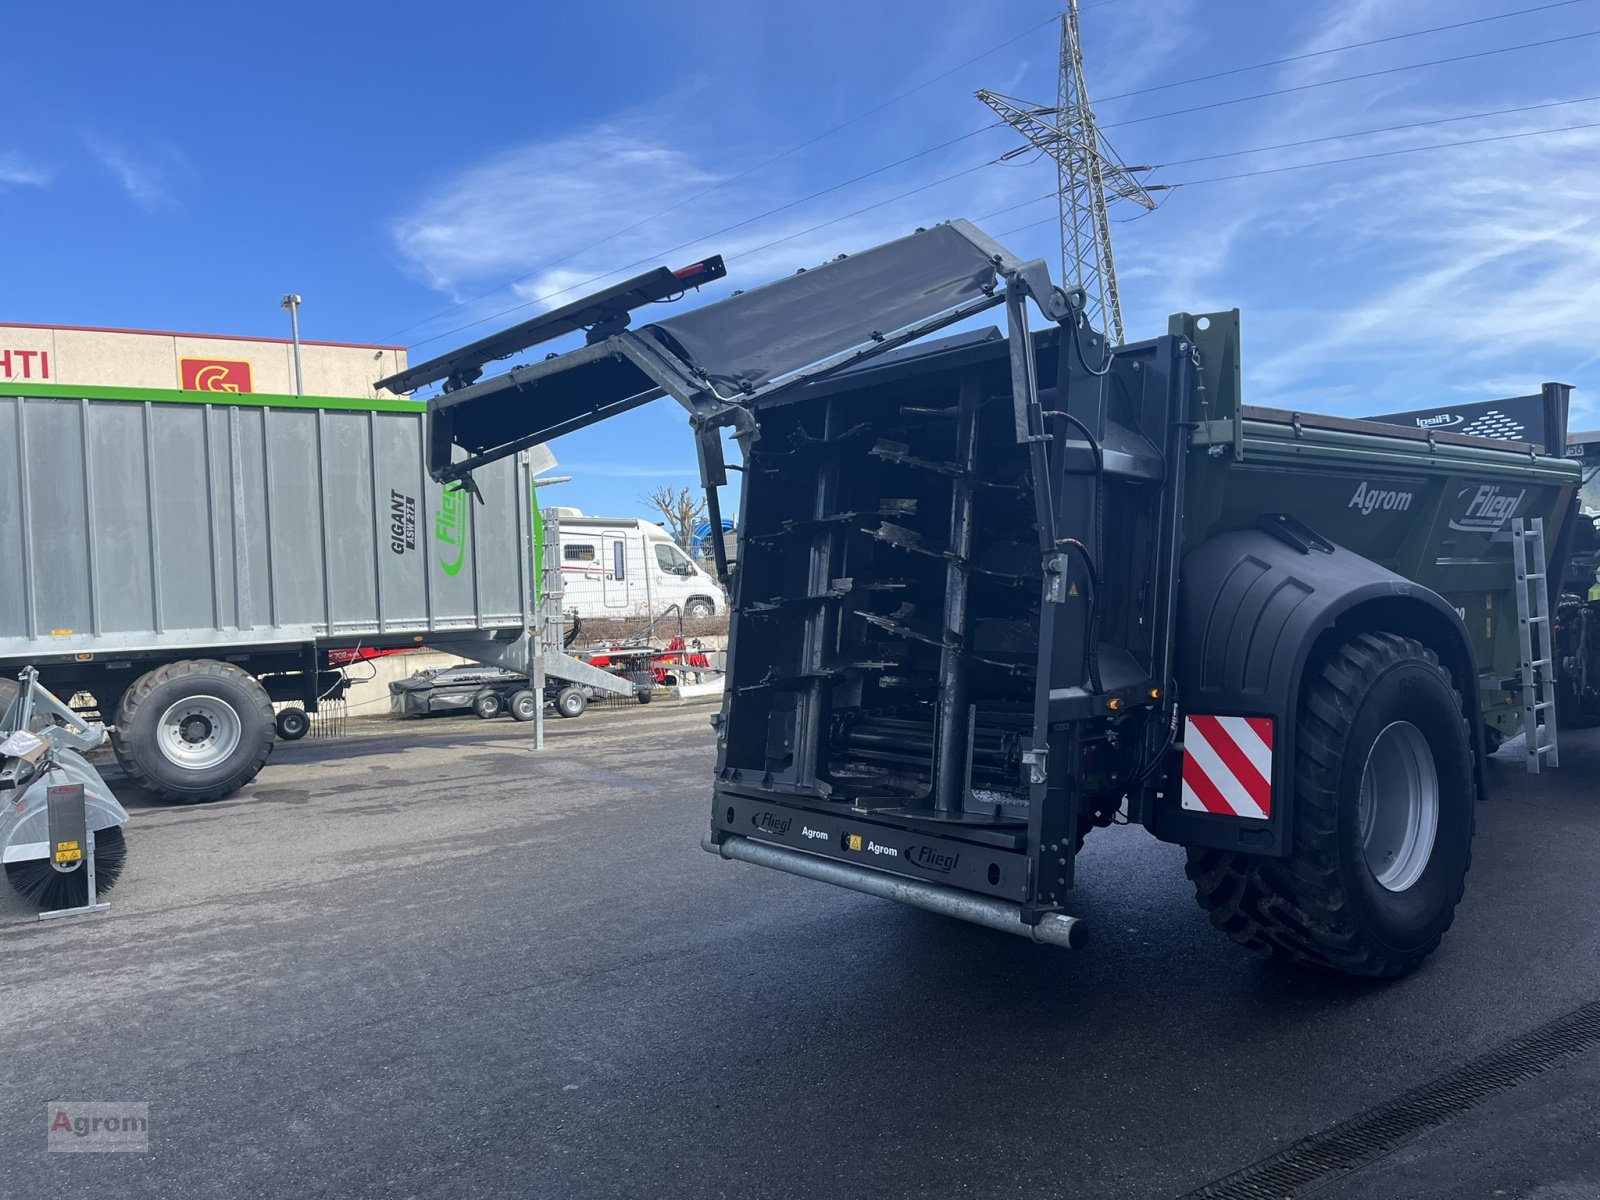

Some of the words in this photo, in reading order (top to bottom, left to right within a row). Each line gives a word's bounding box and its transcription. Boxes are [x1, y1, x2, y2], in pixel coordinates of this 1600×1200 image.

[1348, 481, 1413, 516] Agrom
[1465, 484, 1526, 525] Fliegl
[391, 489, 405, 555] GIGANT
[406, 503, 415, 521] 271
[406, 522, 415, 544] ASW
[761, 812, 793, 834] Fliegl
[802, 826, 829, 840] Agrom
[867, 841, 898, 857] Agrom
[918, 846, 960, 872] Fliegl
